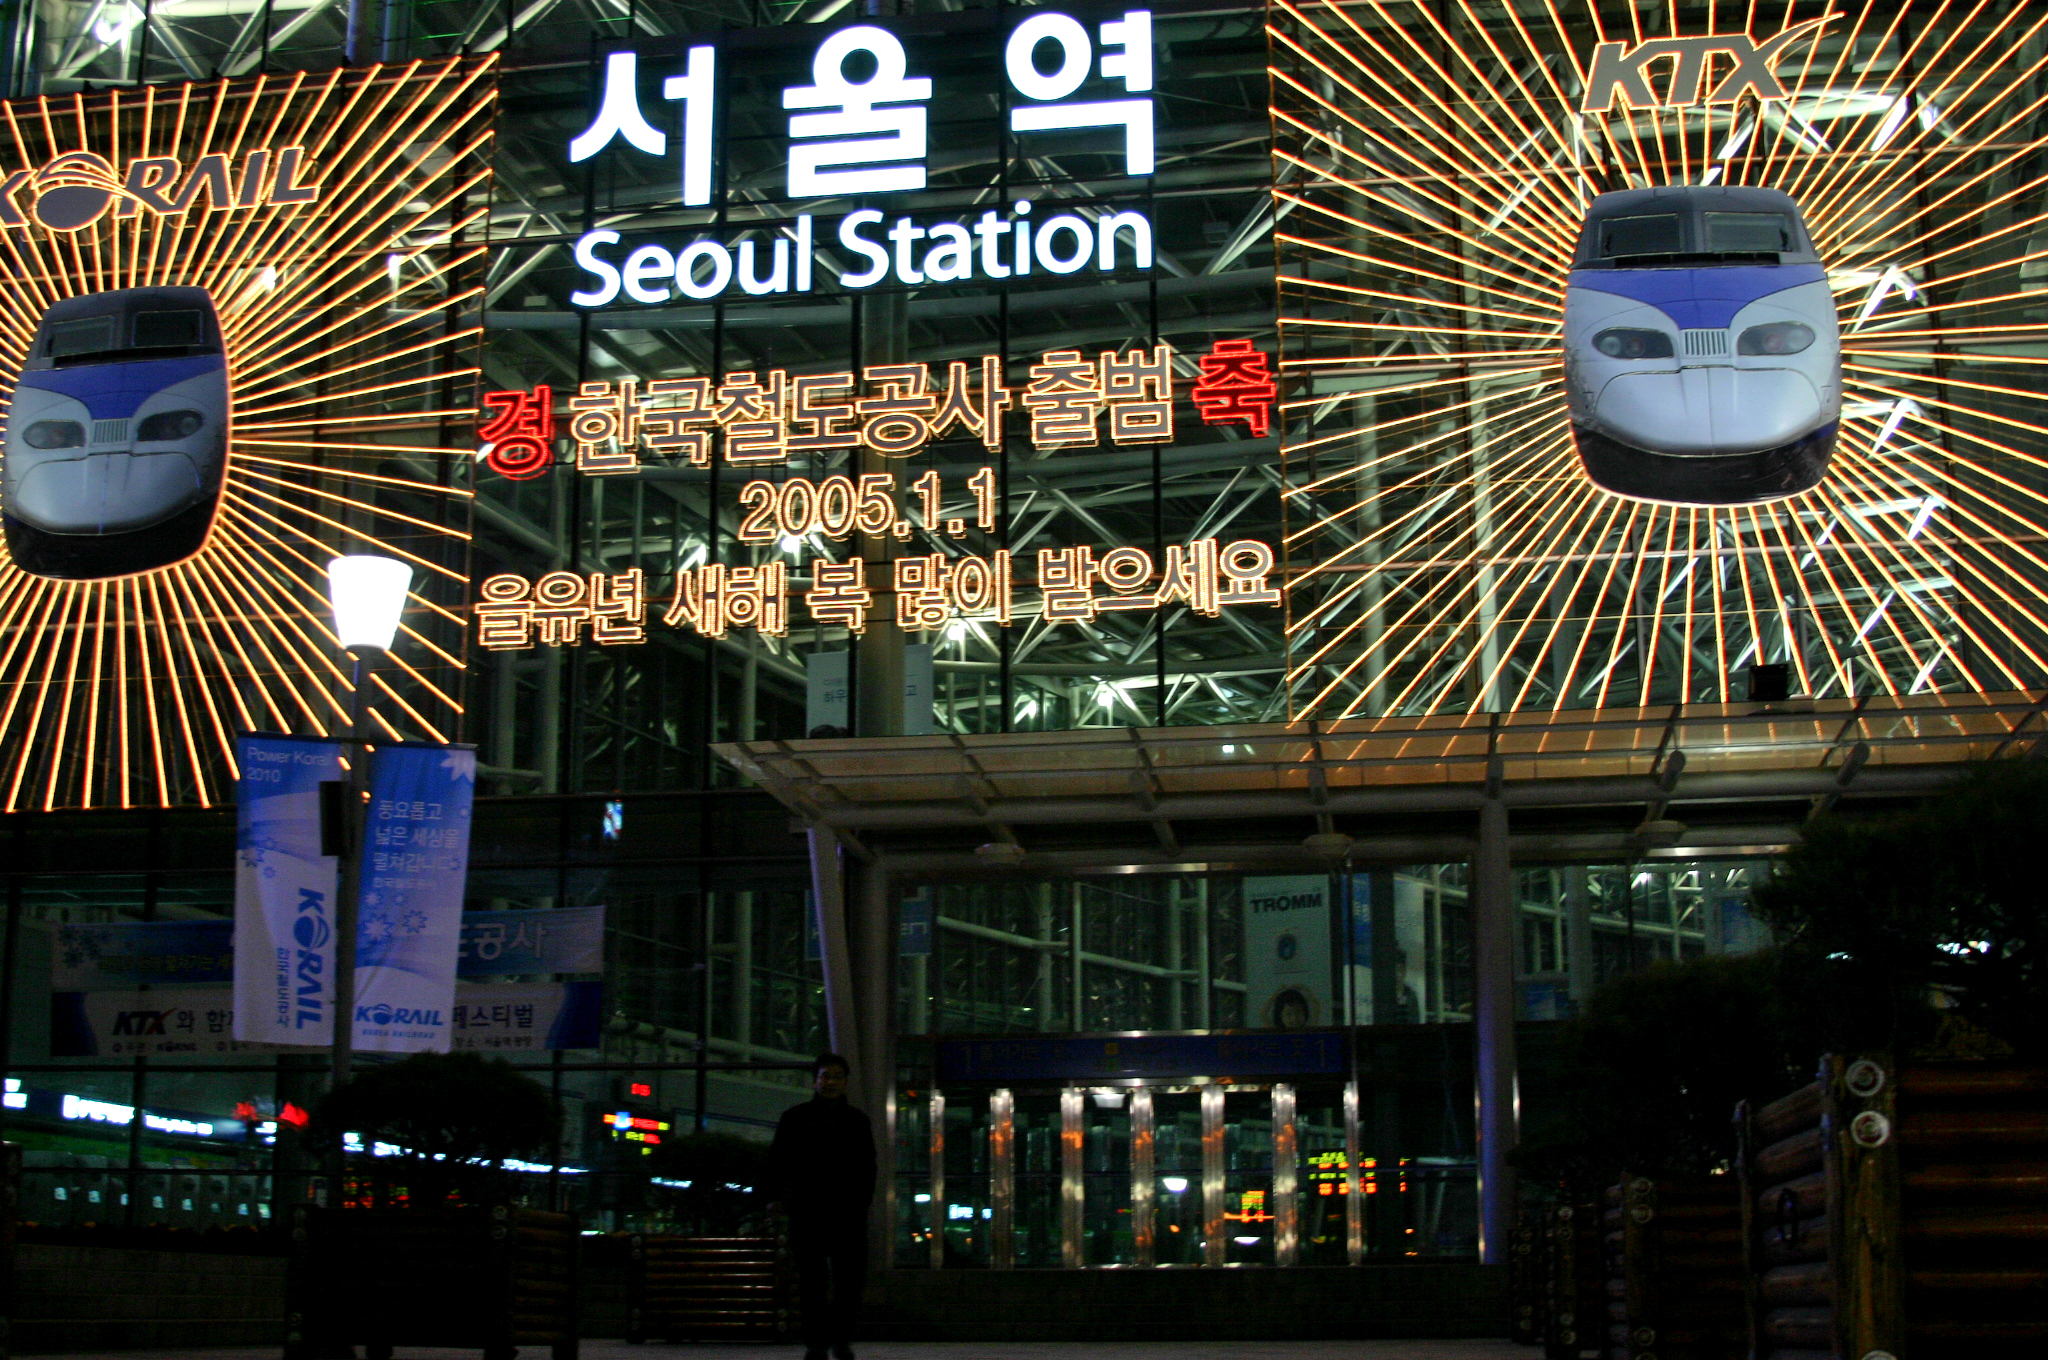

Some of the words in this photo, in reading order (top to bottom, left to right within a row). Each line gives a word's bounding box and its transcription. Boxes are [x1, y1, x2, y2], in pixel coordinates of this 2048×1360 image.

[1580, 12, 1846, 114] KTX
[569, 10, 1156, 207] 서울역
[0, 150, 321, 233] KORAIL
[571, 214, 813, 308] Seoul
[838, 199, 1154, 289] Station
[479, 384, 553, 478] 경
[569, 354, 1011, 474] 한국철도공사
[1020, 344, 1174, 450] 출범
[1191, 338, 1277, 438] 축
[737, 466, 997, 544] 2005.1.1
[474, 567, 646, 648] 을유년
[663, 560, 788, 639] 새해
[805, 556, 871, 632] 복
[894, 549, 1012, 630] 많이
[1037, 537, 1281, 622] 받으세요
[246, 767, 282, 783] 2010
[247, 747, 290, 763] Power
[375, 826, 408, 846] 넓은
[410, 827, 461, 849] 세상을
[378, 800, 442, 821] 풍요롭고
[1250, 893, 1322, 914] TROMM
[293, 887, 330, 1030] KORAIL
[355, 1003, 444, 1026] KORAIL
